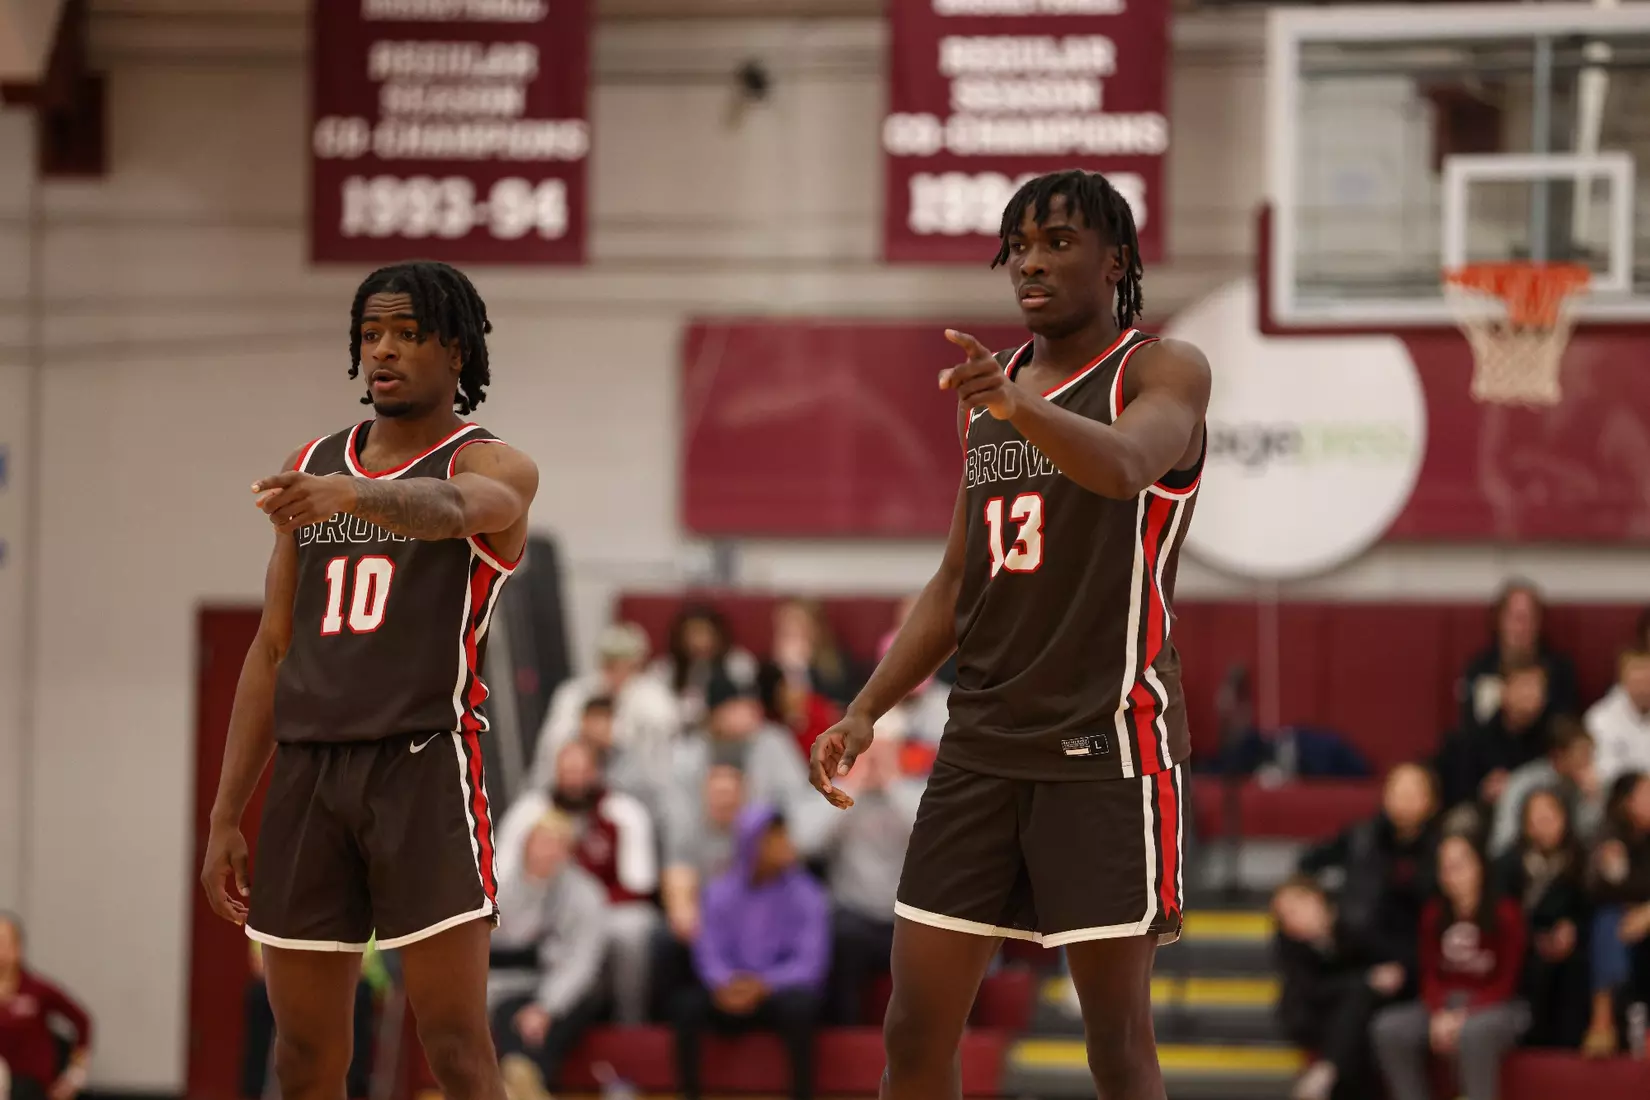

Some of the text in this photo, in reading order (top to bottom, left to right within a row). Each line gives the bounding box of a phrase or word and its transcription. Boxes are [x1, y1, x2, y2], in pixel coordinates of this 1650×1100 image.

[368, 42, 539, 80] REGULAR
[939, 36, 1116, 76] REGULAR
[380, 83, 525, 116] SEASON
[951, 77, 1103, 111] SEASON
[314, 117, 588, 159] CO-CHAMPIONS
[884, 113, 1168, 155] CO-CHAMPIONS
[341, 176, 567, 238] 1993-94
[966, 440, 1063, 489] BROW
[984, 491, 1044, 579] 13
[320, 554, 396, 636] 10
